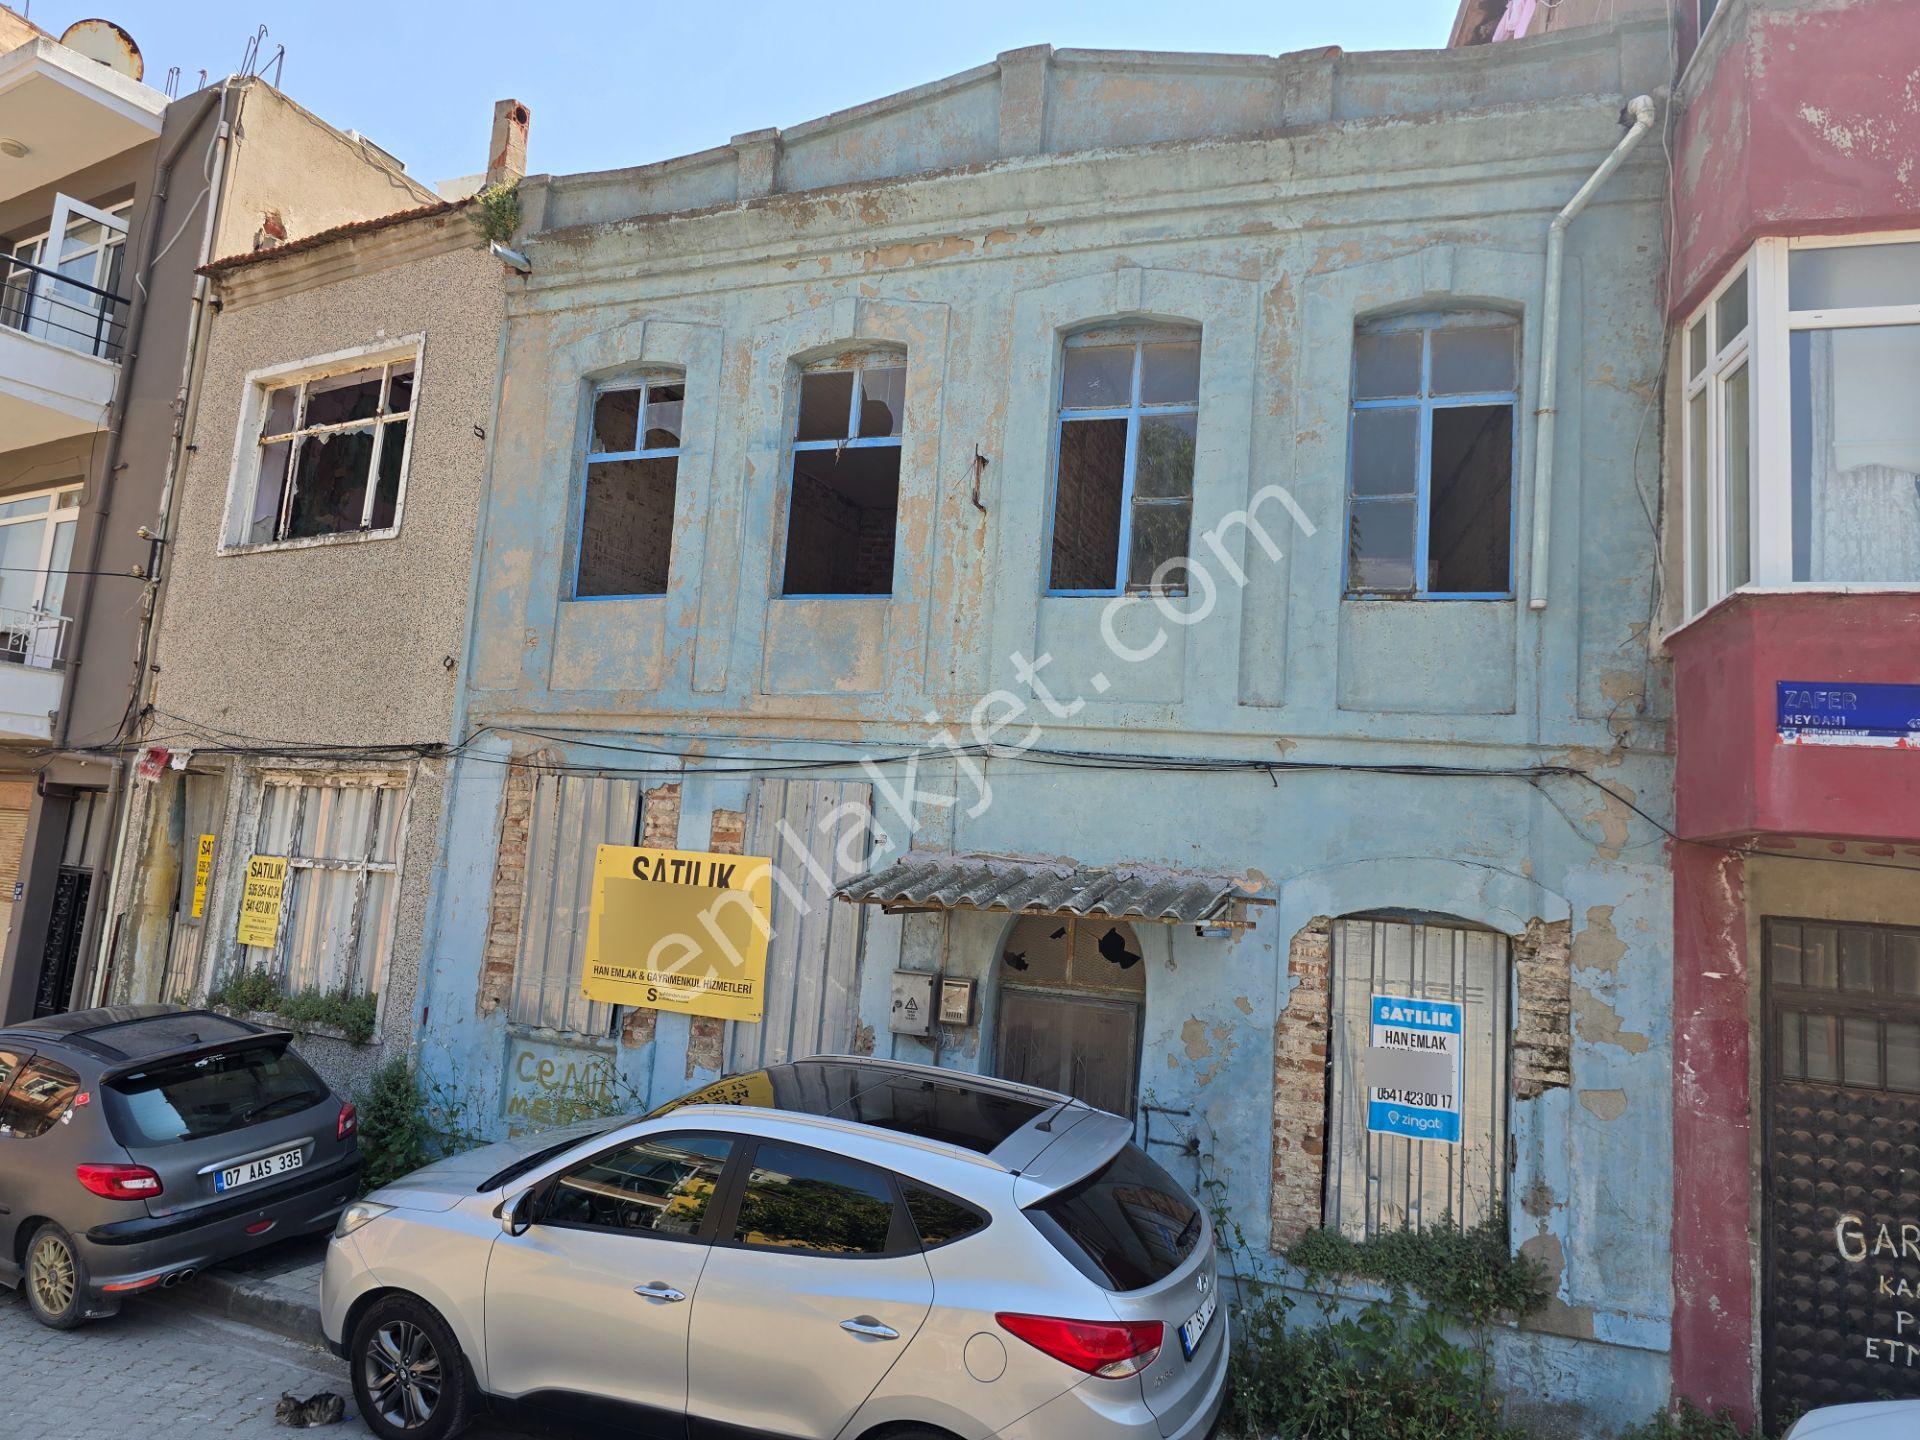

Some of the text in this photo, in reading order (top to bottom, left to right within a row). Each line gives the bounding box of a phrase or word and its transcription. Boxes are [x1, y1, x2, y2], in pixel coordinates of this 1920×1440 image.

[1784, 690, 1857, 710] ZAFER
[251, 861, 284, 879] SATILIK
[593, 965, 753, 994] HAN EMLAK & GAYRİMENKUL HİZMETLERİ
[1380, 1005, 1453, 1027] SATILIK
[1385, 1030, 1408, 1046] HAN
[1410, 1033, 1447, 1051] EMLAK
[1441, 1094, 1453, 1109] 17
[1402, 1113, 1441, 1131] zingat
[225, 1151, 301, 1186] 07 AAS 335
